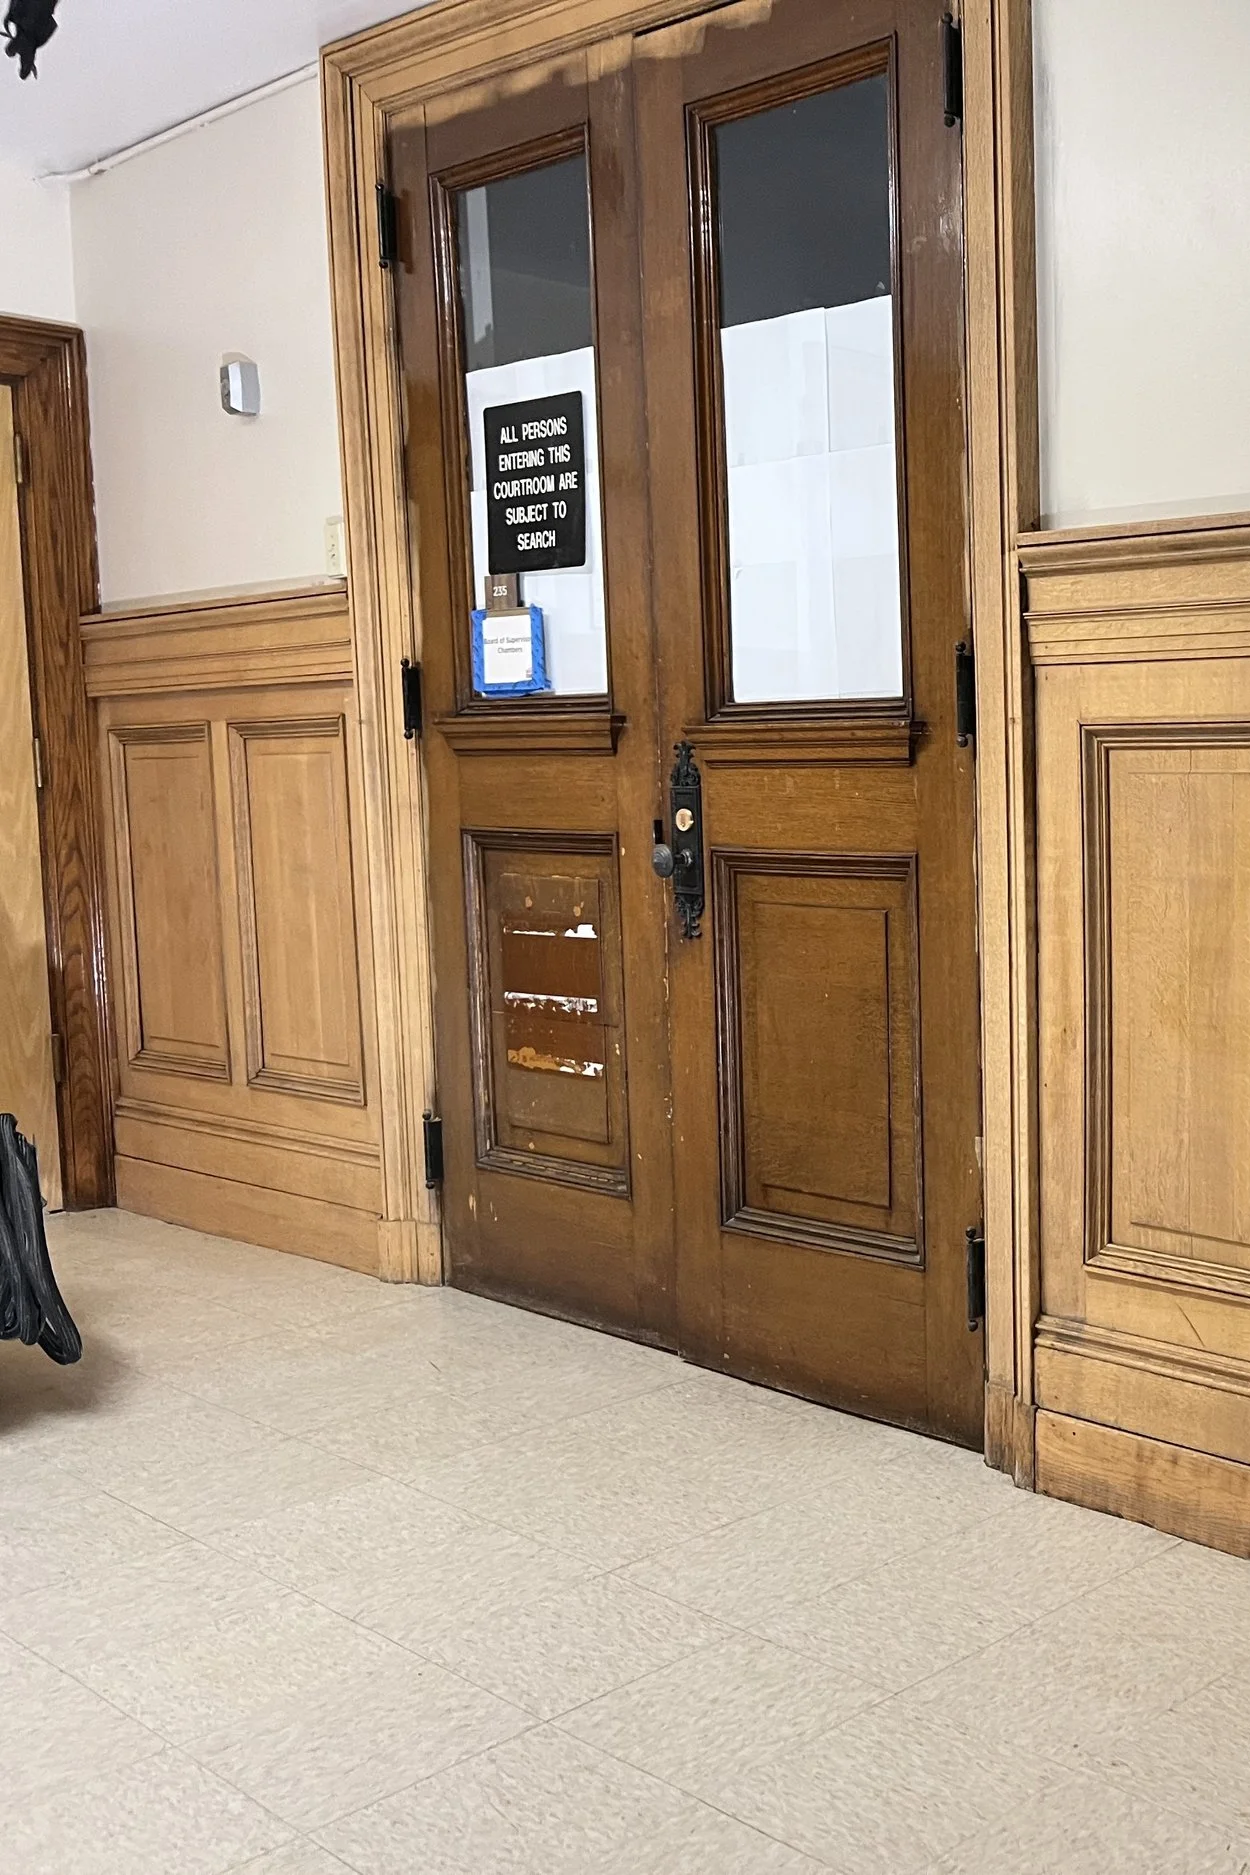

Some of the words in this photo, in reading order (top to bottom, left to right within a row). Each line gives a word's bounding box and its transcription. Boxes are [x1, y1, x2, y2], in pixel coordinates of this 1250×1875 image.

[500, 425, 519, 445] ALL
[521, 416, 567, 441] PERSONS
[498, 448, 545, 472] ENTERING
[547, 444, 571, 464] THIS
[493, 474, 555, 500] COURTROOM
[558, 471, 578, 491] ARE
[505, 503, 549, 526] SUBJECT
[552, 500, 567, 519] TO
[517, 530, 556, 551] SEARCH
[493, 585, 508, 597] 235
